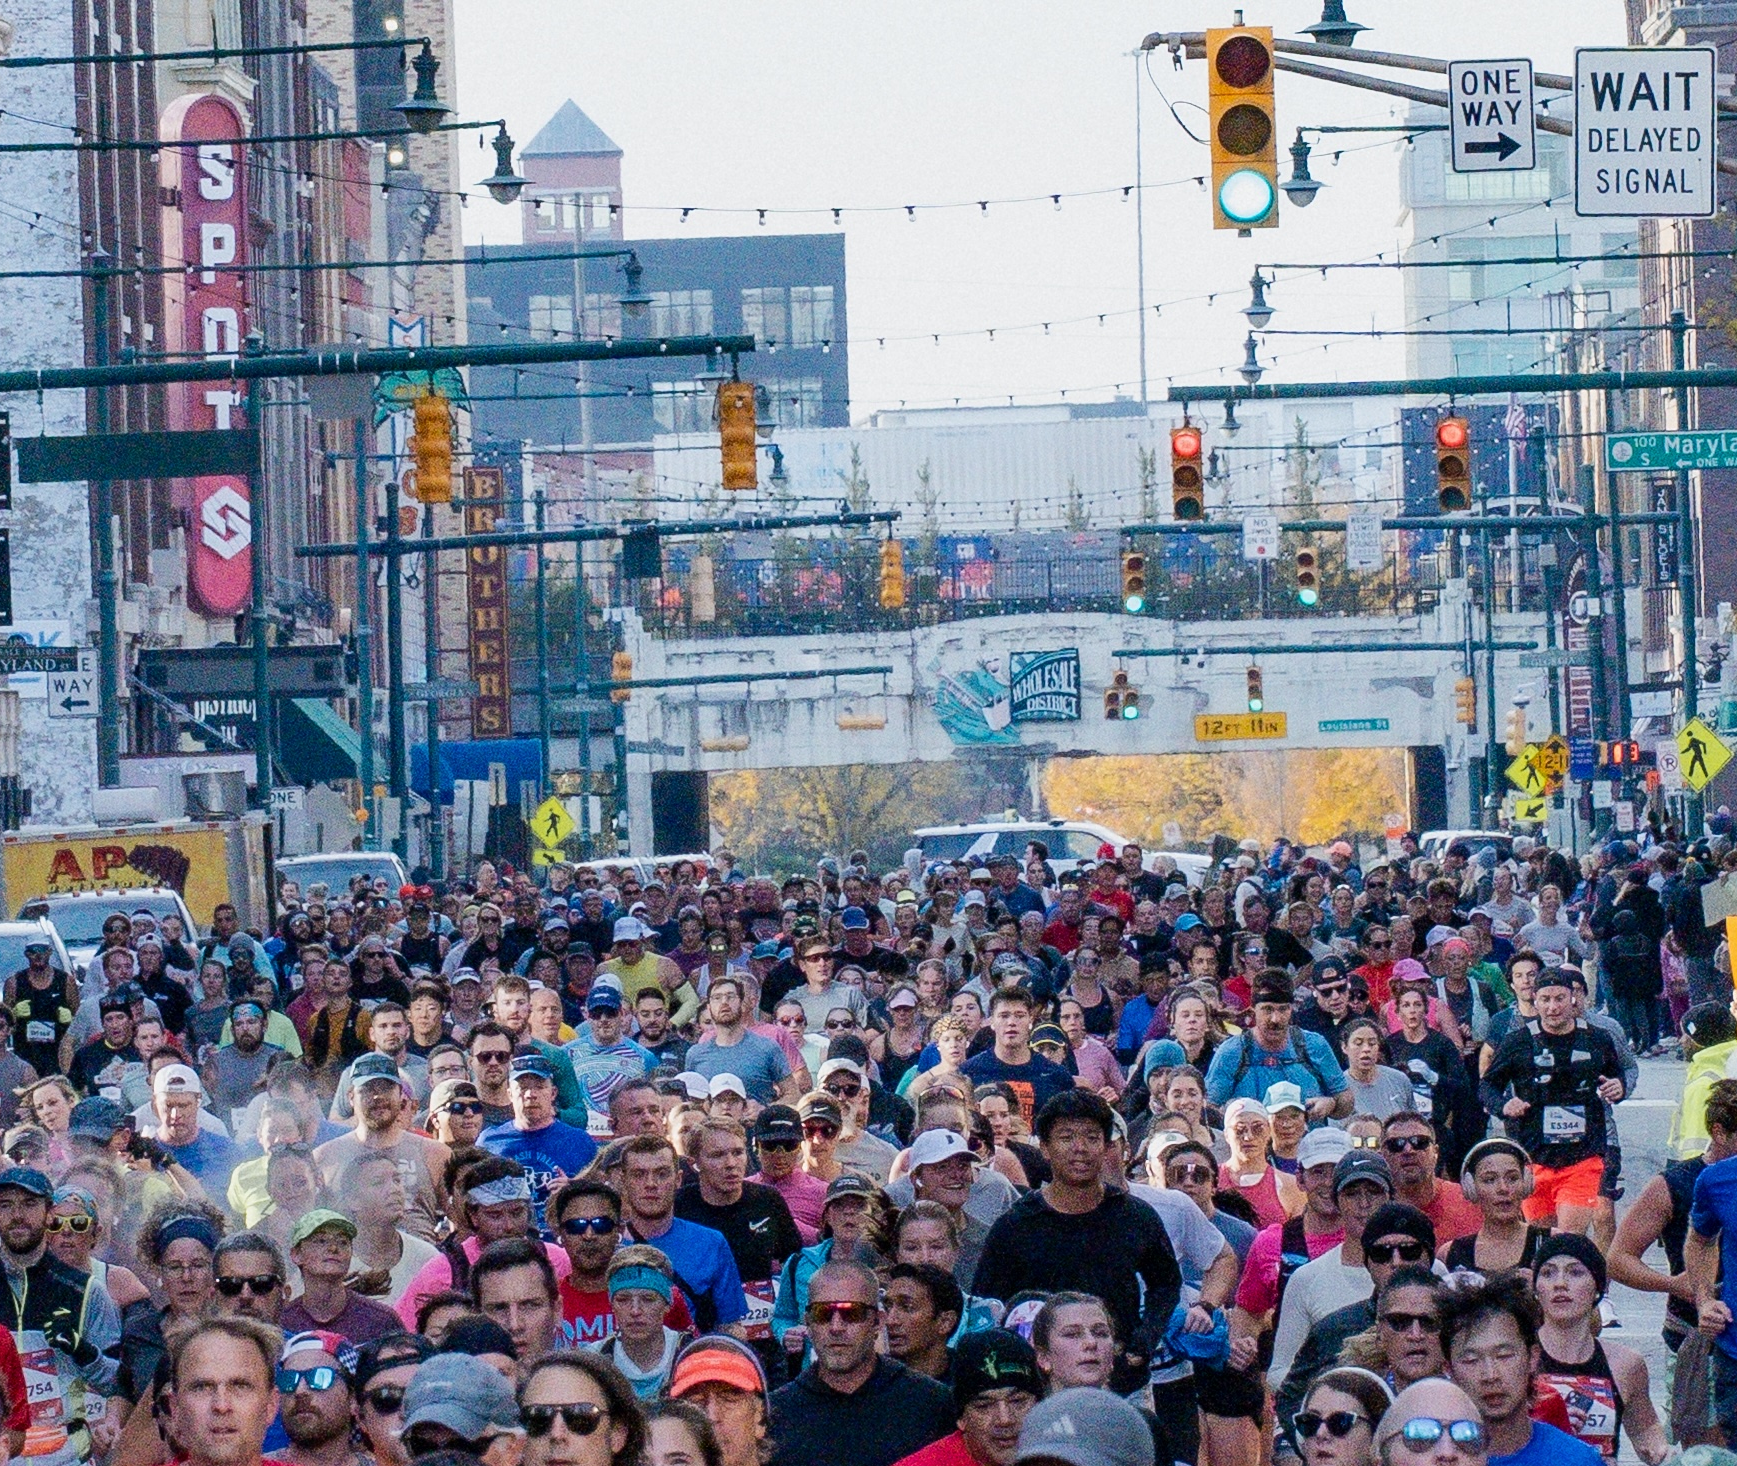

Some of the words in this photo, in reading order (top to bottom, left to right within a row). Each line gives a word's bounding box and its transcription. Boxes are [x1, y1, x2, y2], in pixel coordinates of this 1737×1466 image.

[1461, 70, 1521, 96] ONE
[1591, 72, 1699, 111] WAIT
[1461, 102, 1522, 127] WAY
[1588, 127, 1701, 154] DELAYED
[1596, 168, 1694, 195] SIGNAL
[1633, 437, 1657, 448] 100
[1640, 453, 1651, 466] S
[1696, 457, 1719, 467] ONE
[472, 472, 502, 730] BROTHERS
[52, 678, 94, 693] WAY
[1012, 657, 1078, 704] WHOLESALE
